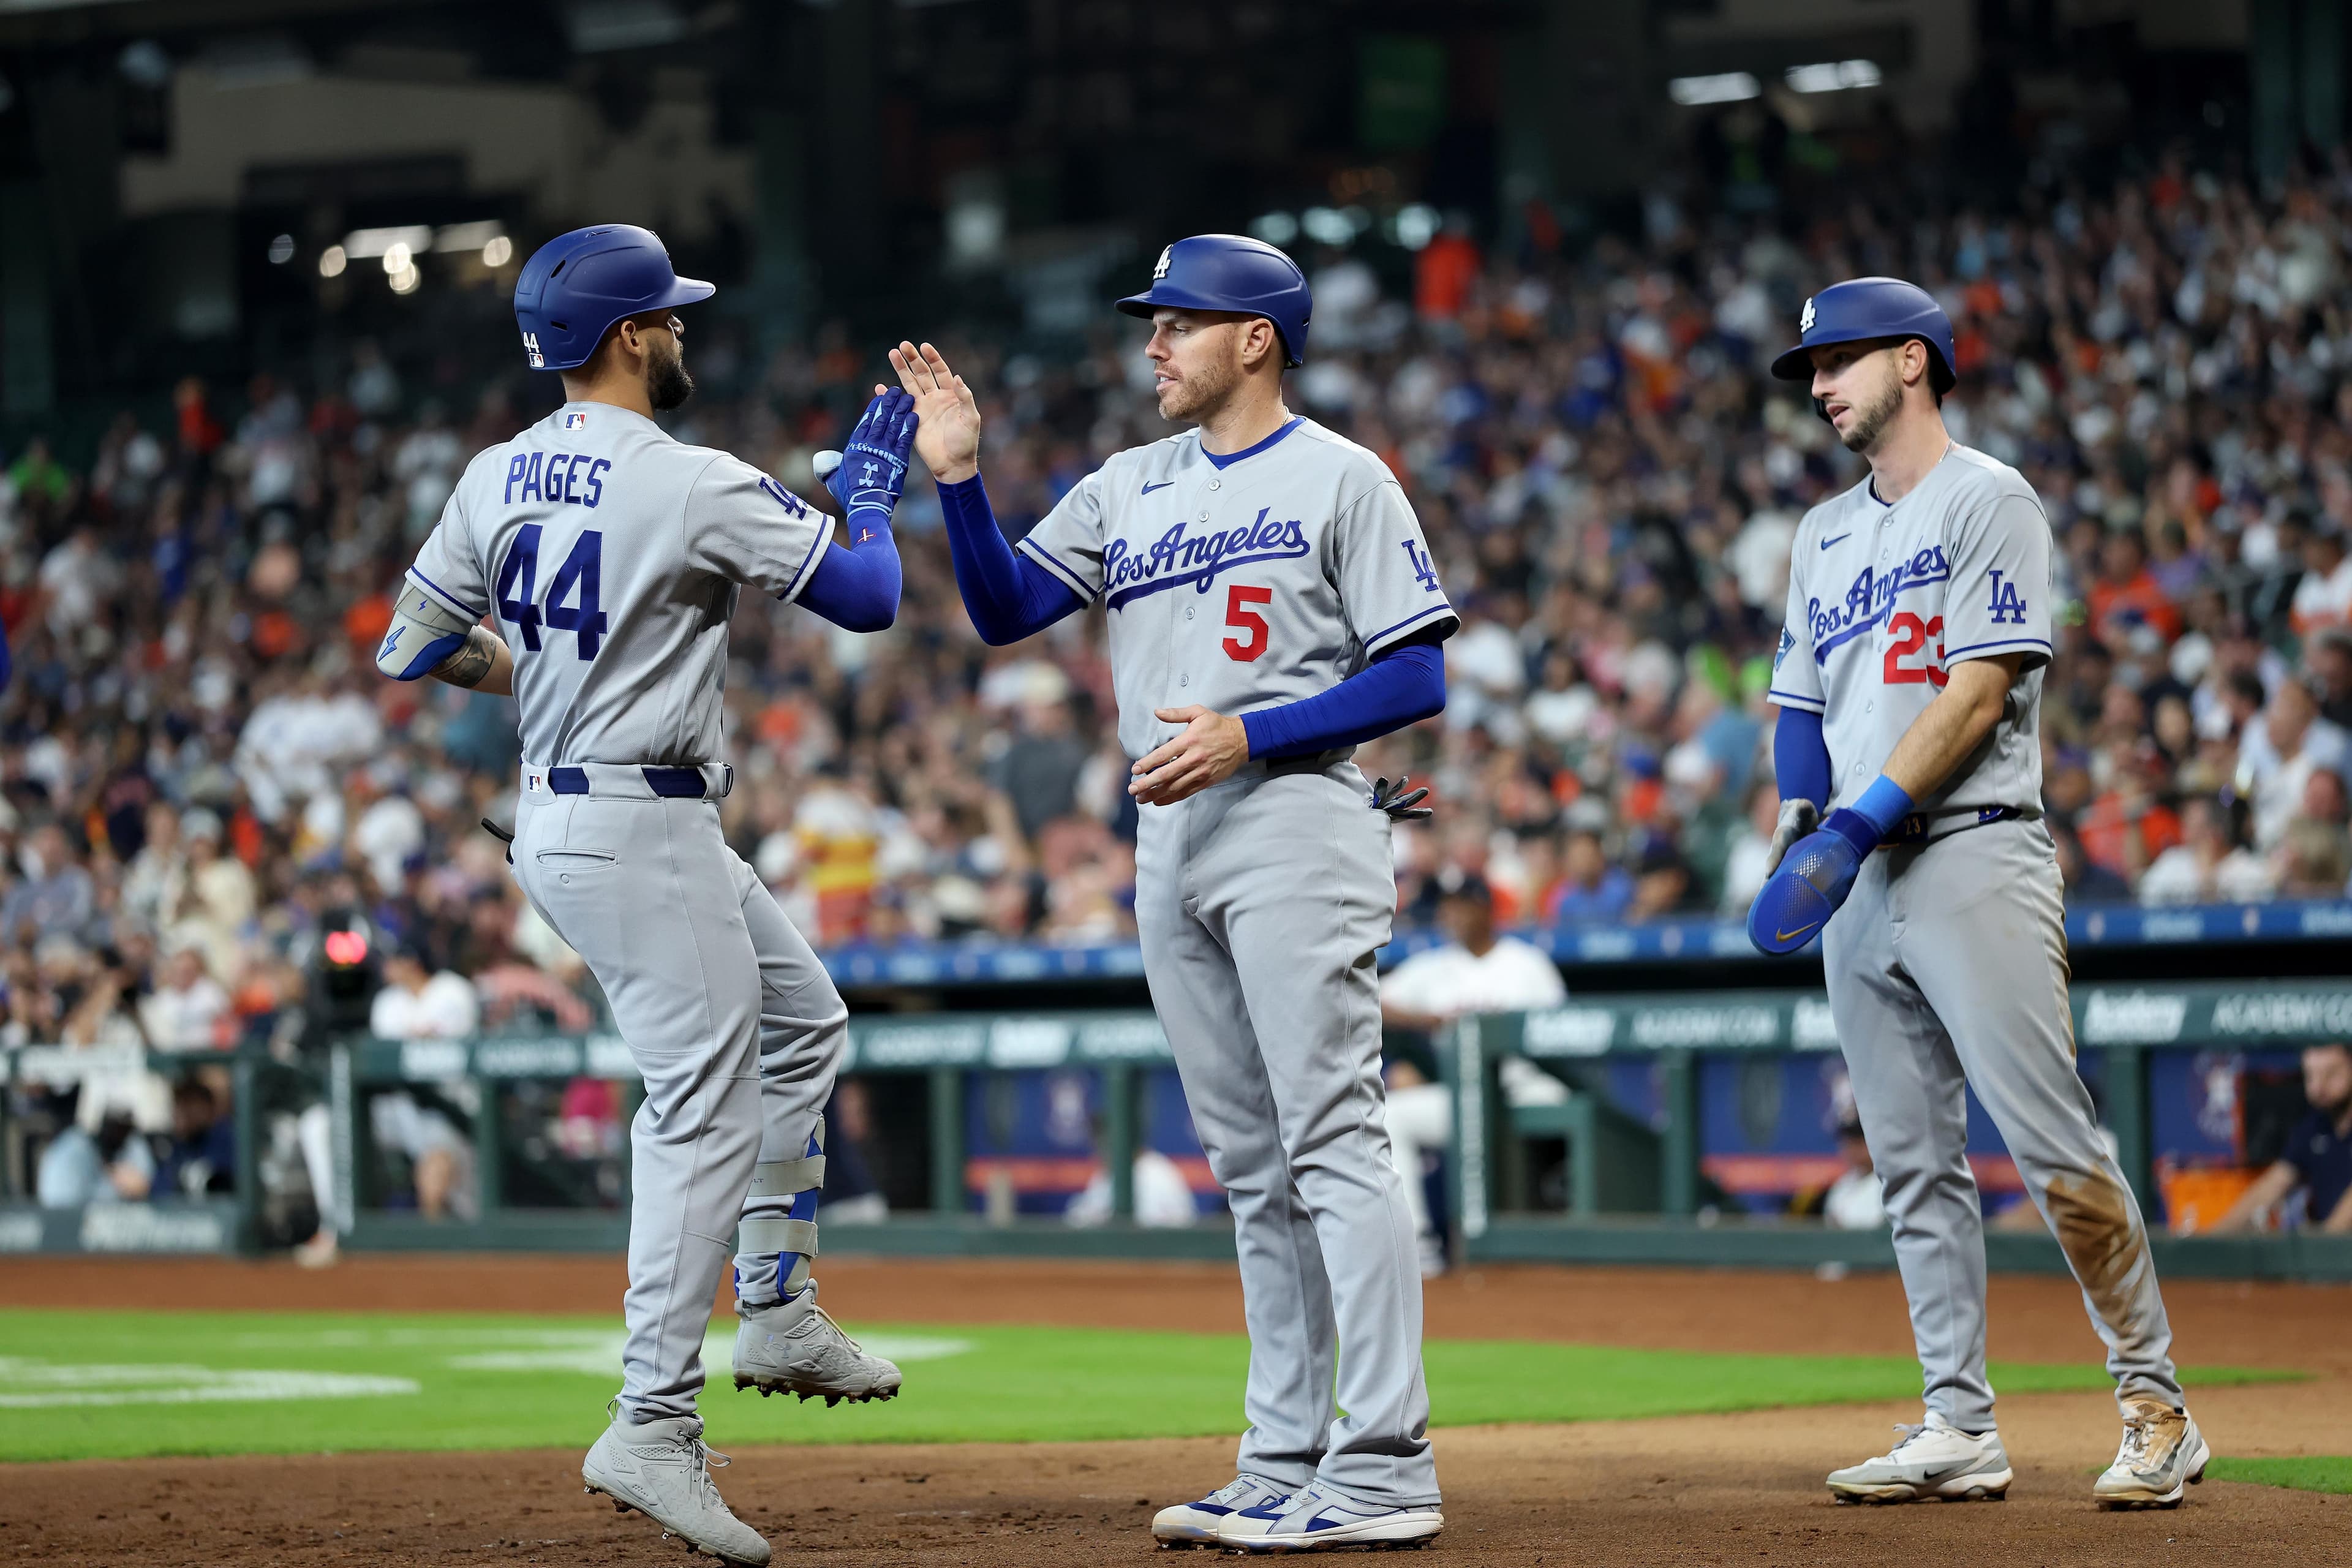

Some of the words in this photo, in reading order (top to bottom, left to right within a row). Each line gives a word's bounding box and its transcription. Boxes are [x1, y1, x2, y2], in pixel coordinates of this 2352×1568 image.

[523, 331, 540, 353] 44
[504, 452, 611, 508] PAGES
[1103, 538, 1144, 592] Los
[1145, 507, 1310, 594] Angeles
[1843, 535, 1950, 628] Anges
[497, 523, 607, 661] 44
[1222, 585, 1272, 662] 5
[1988, 570, 2026, 624] LA
[1904, 817, 1921, 835] 23
